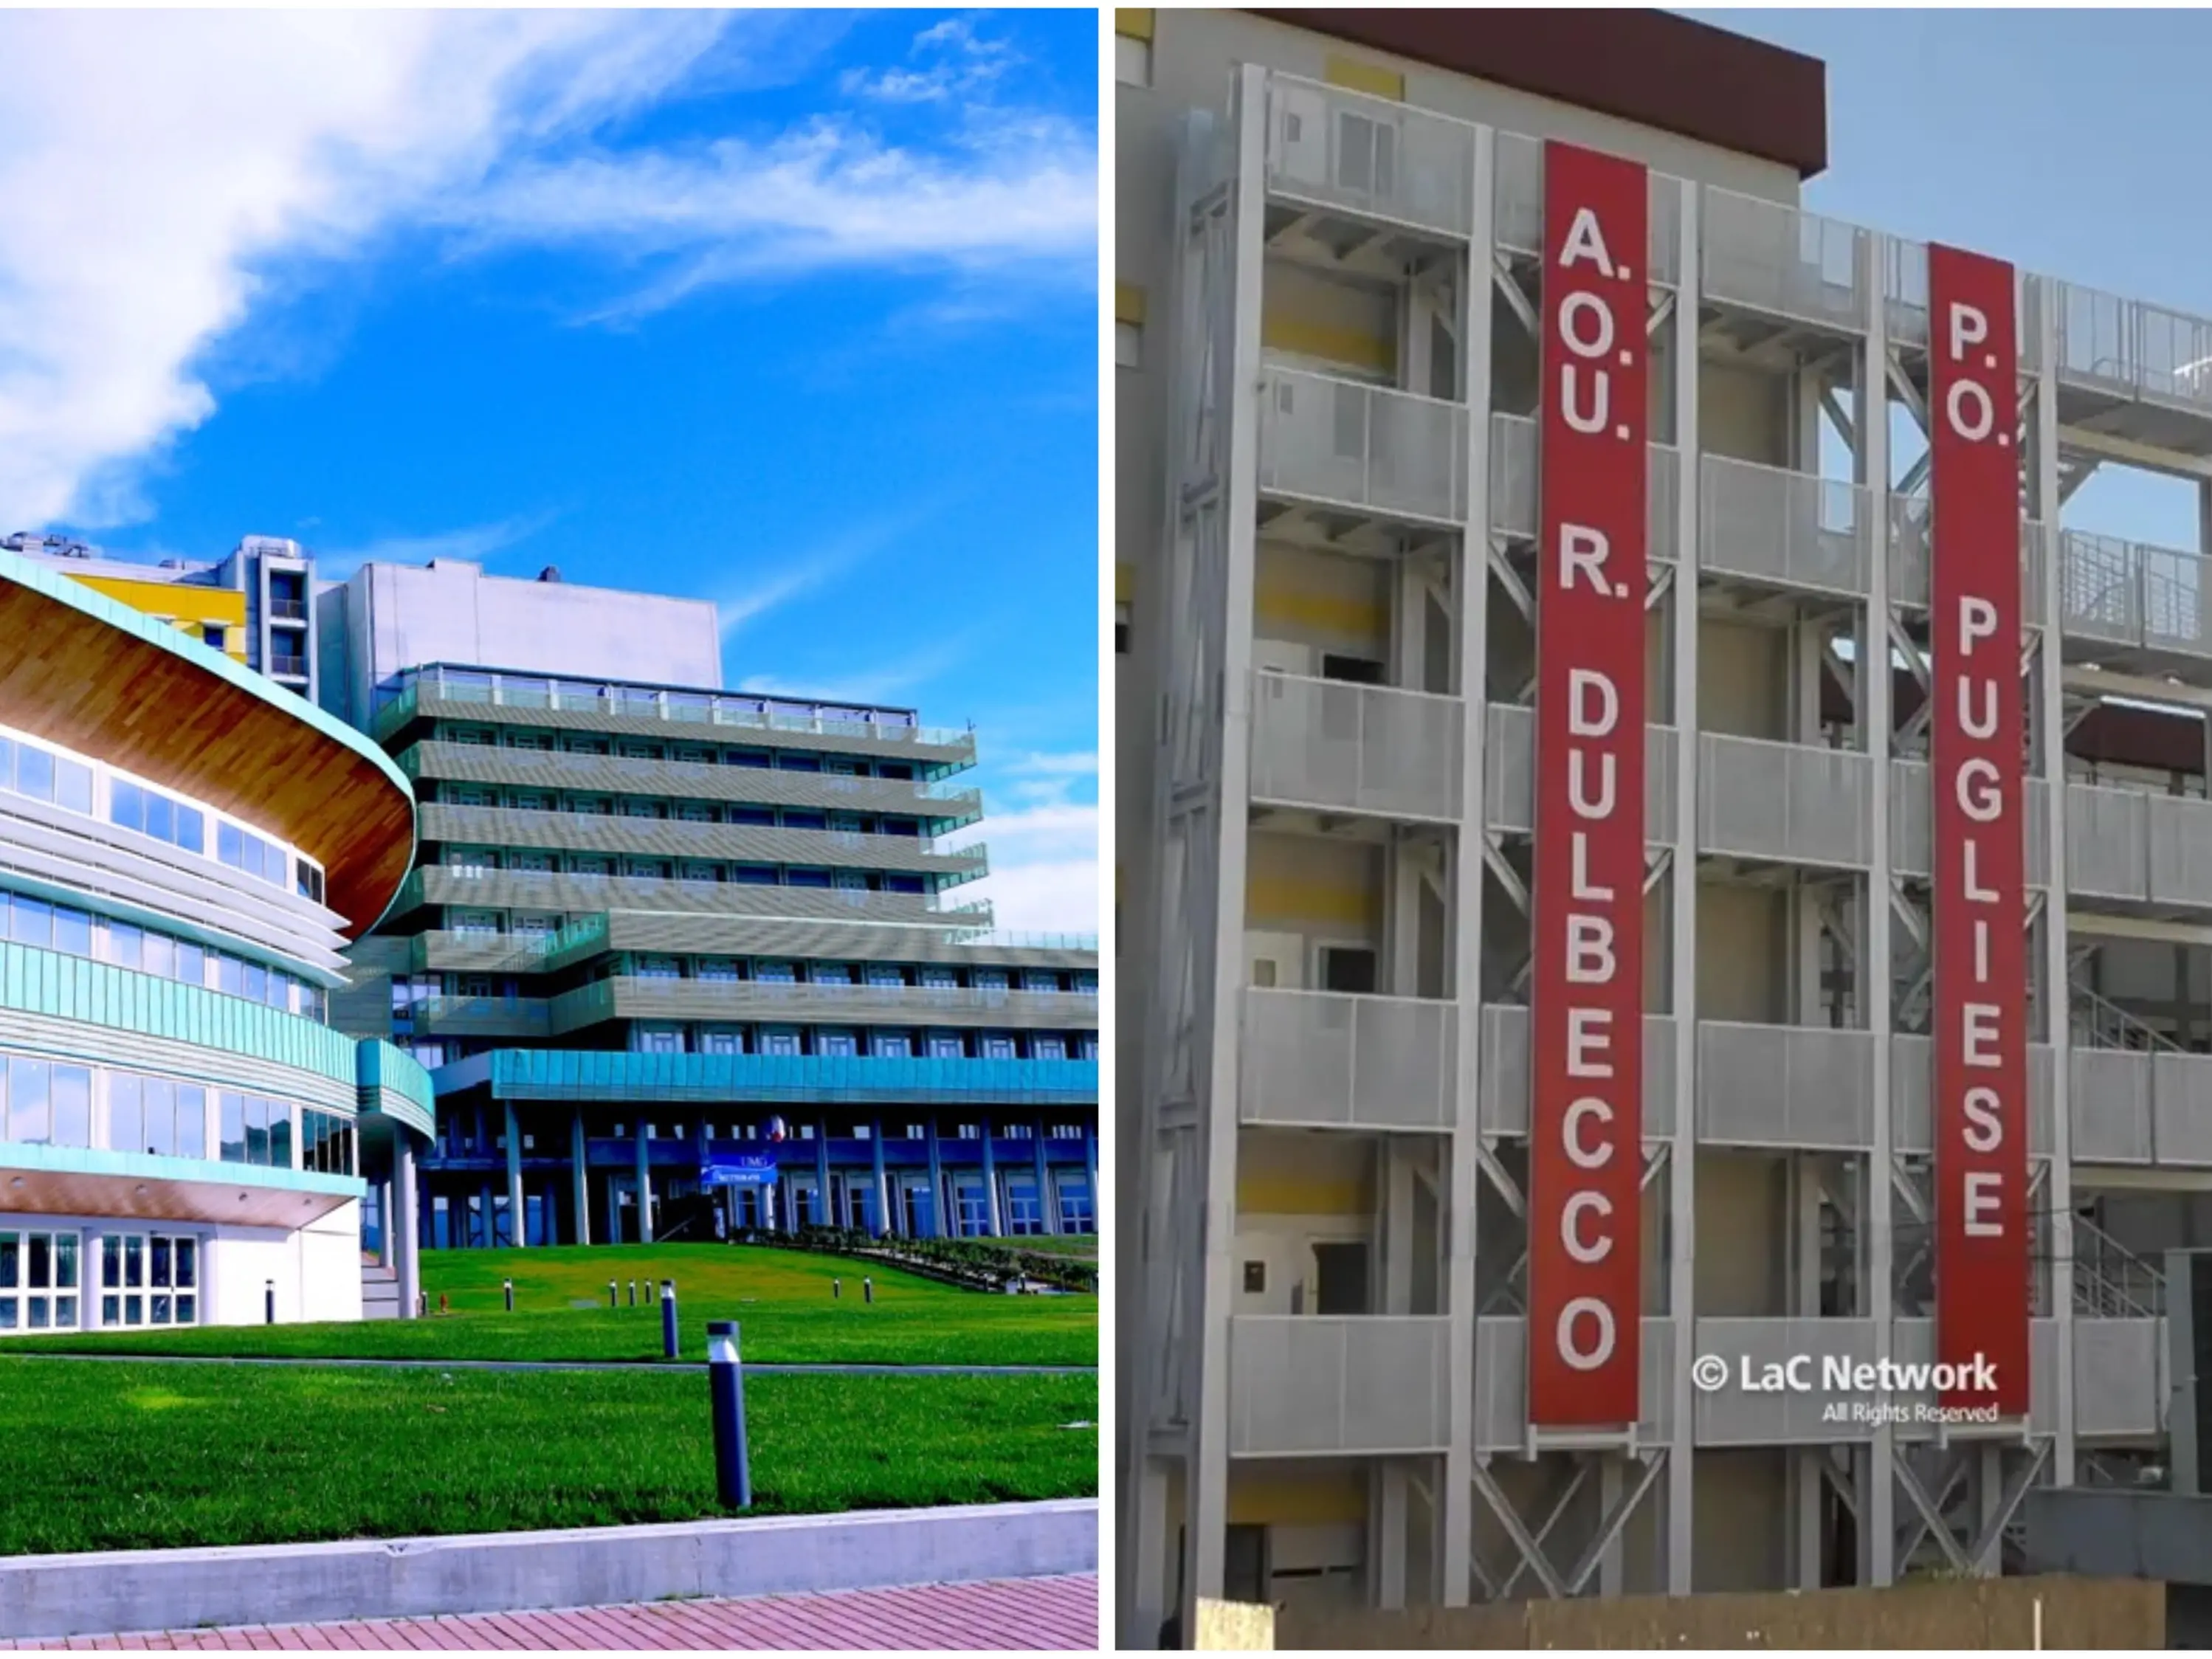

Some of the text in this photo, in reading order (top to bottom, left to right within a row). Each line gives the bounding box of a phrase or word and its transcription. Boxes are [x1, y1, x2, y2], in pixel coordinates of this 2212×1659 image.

[1555, 207, 1633, 1371] A.O.U. R. DULBECCO
[1946, 300, 2010, 1237] P.O. PUGLIESE
